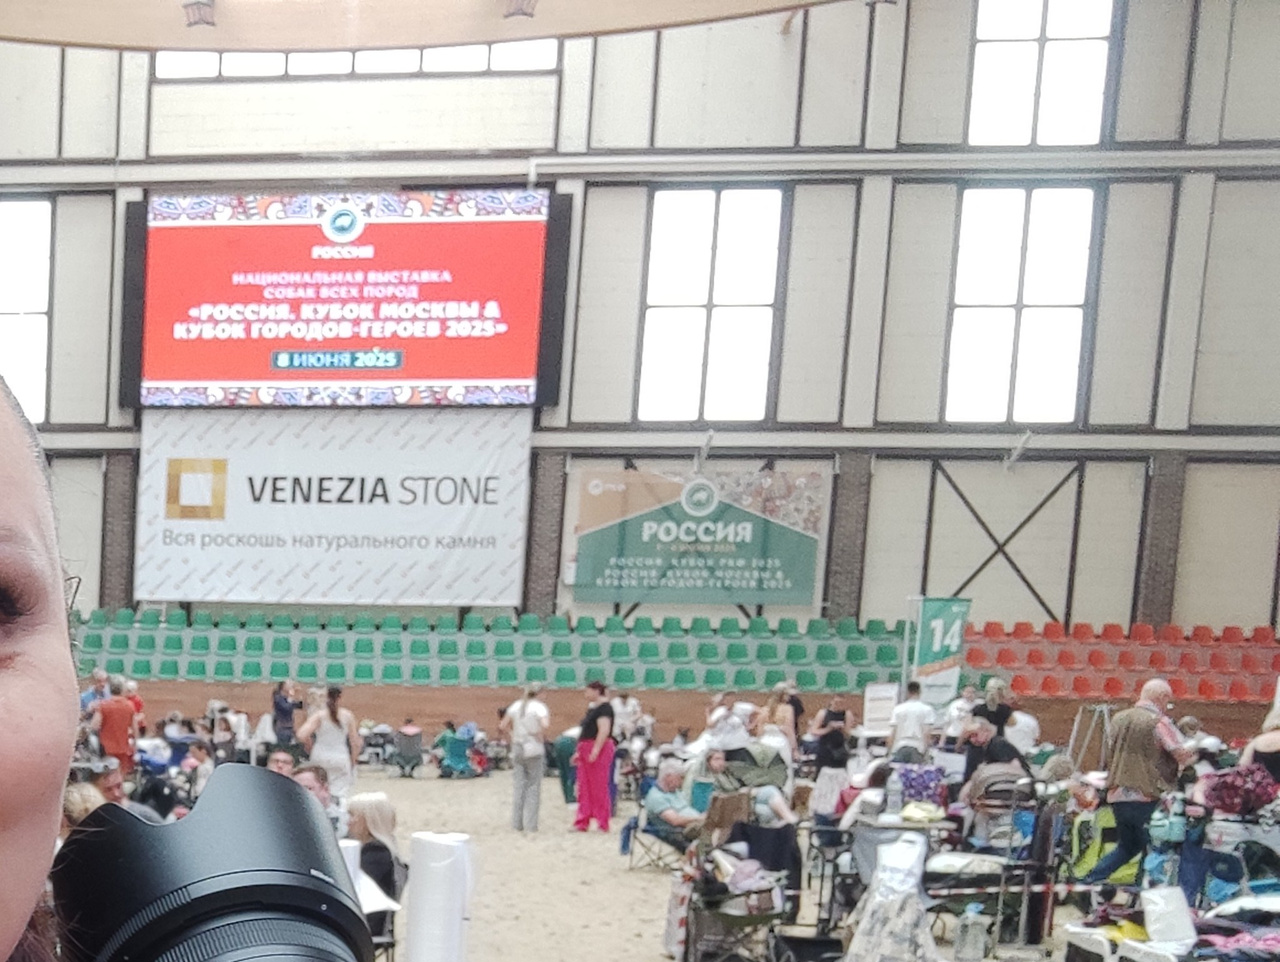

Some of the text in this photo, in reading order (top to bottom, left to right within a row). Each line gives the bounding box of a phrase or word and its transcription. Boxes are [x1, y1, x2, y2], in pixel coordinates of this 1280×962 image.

[311, 245, 374, 260] РОССИЯ
[231, 269, 453, 286] НАЦИОНАЛЬНАЯ ВЫСТАВКА
[263, 284, 419, 299] СОБАК ВСЕХ ПОРОД
[300, 302, 375, 320] КУБОК
[379, 301, 480, 320] МОСКВЫ
[173, 321, 247, 340] КУБОК
[250, 320, 441, 341] ГОРОДОВ-ГЕРОЕВ
[276, 351, 397, 368] 8 ИЮНЯ 2025
[248, 476, 500, 506] VENEZIA STONE
[162, 528, 497, 553] Вся роскошь натурального камня
[641, 521, 753, 543] РОССИЯ
[930, 618, 962, 653] 14
